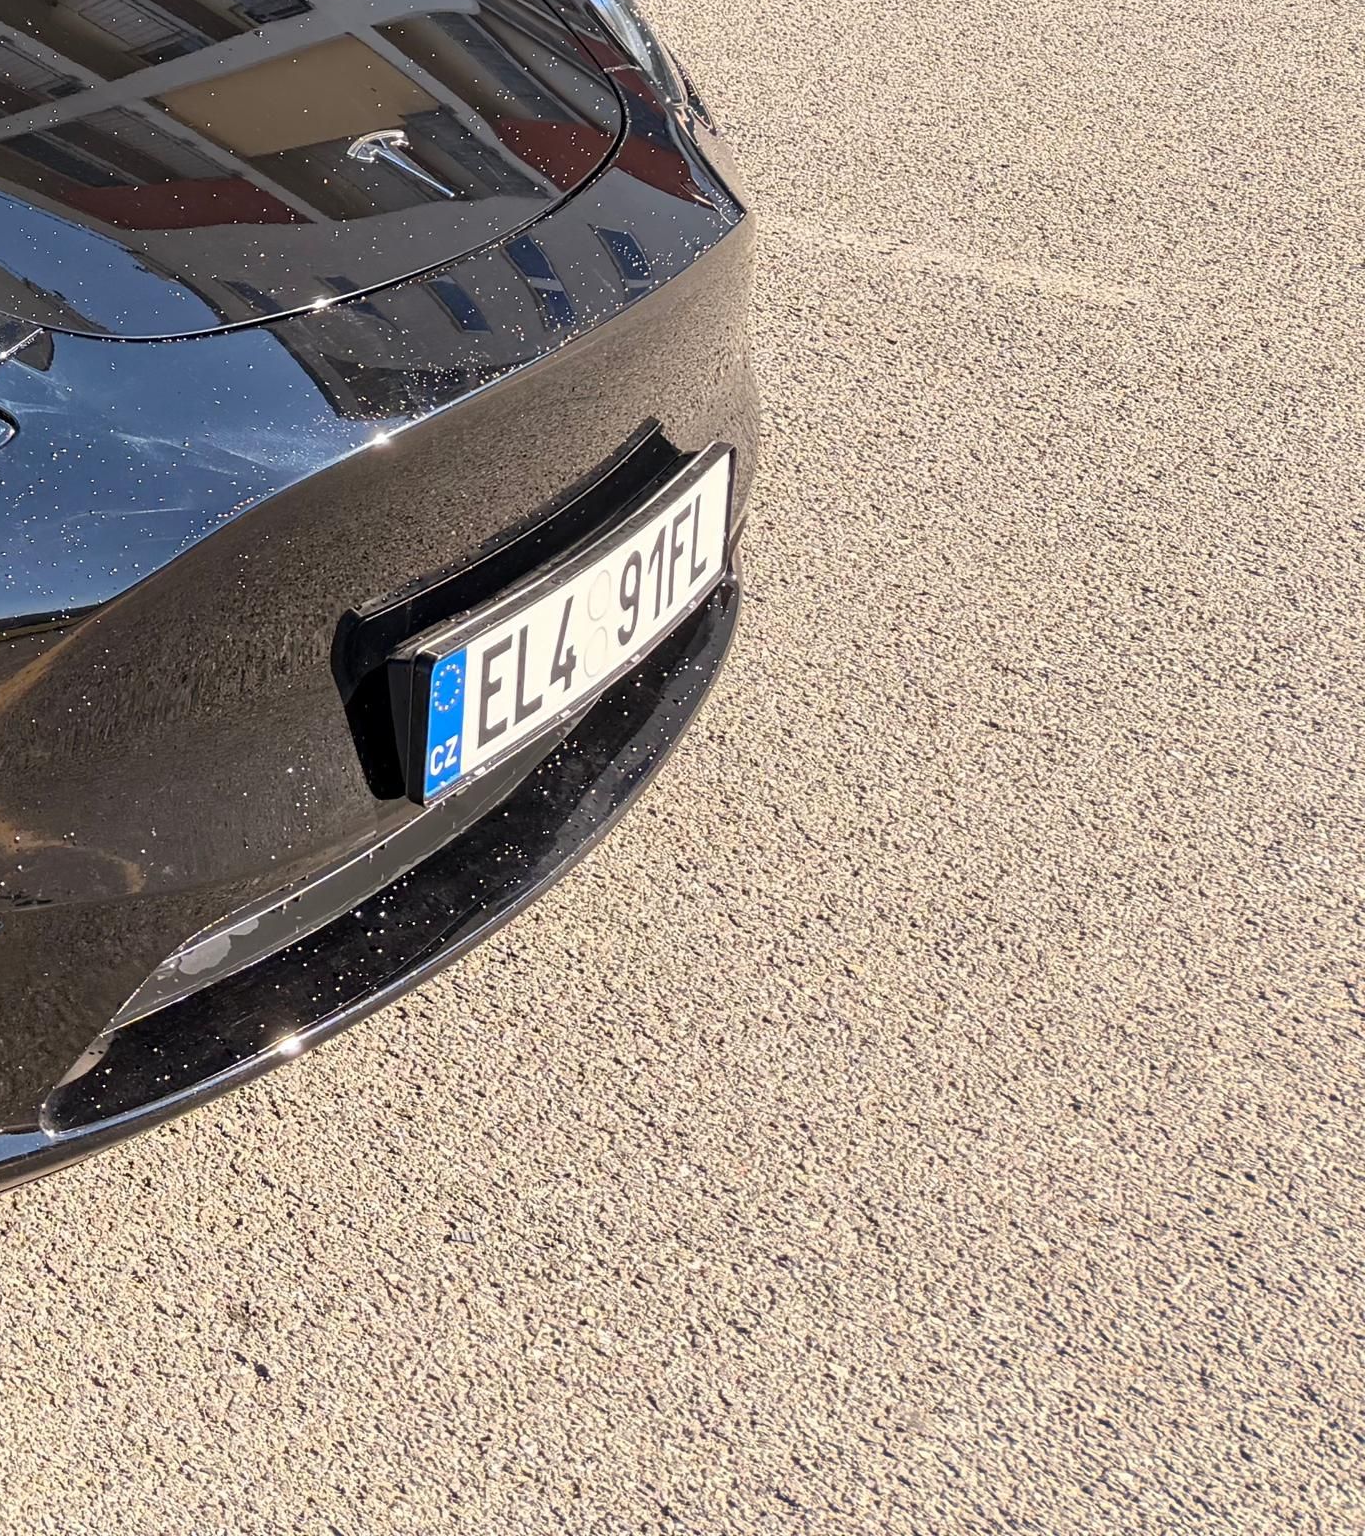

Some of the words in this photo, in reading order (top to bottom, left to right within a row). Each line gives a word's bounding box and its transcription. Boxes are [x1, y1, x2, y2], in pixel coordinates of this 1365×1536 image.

[476, 594, 577, 749] EL4
[616, 494, 708, 646] 91FL
[429, 734, 458, 778] CZ
